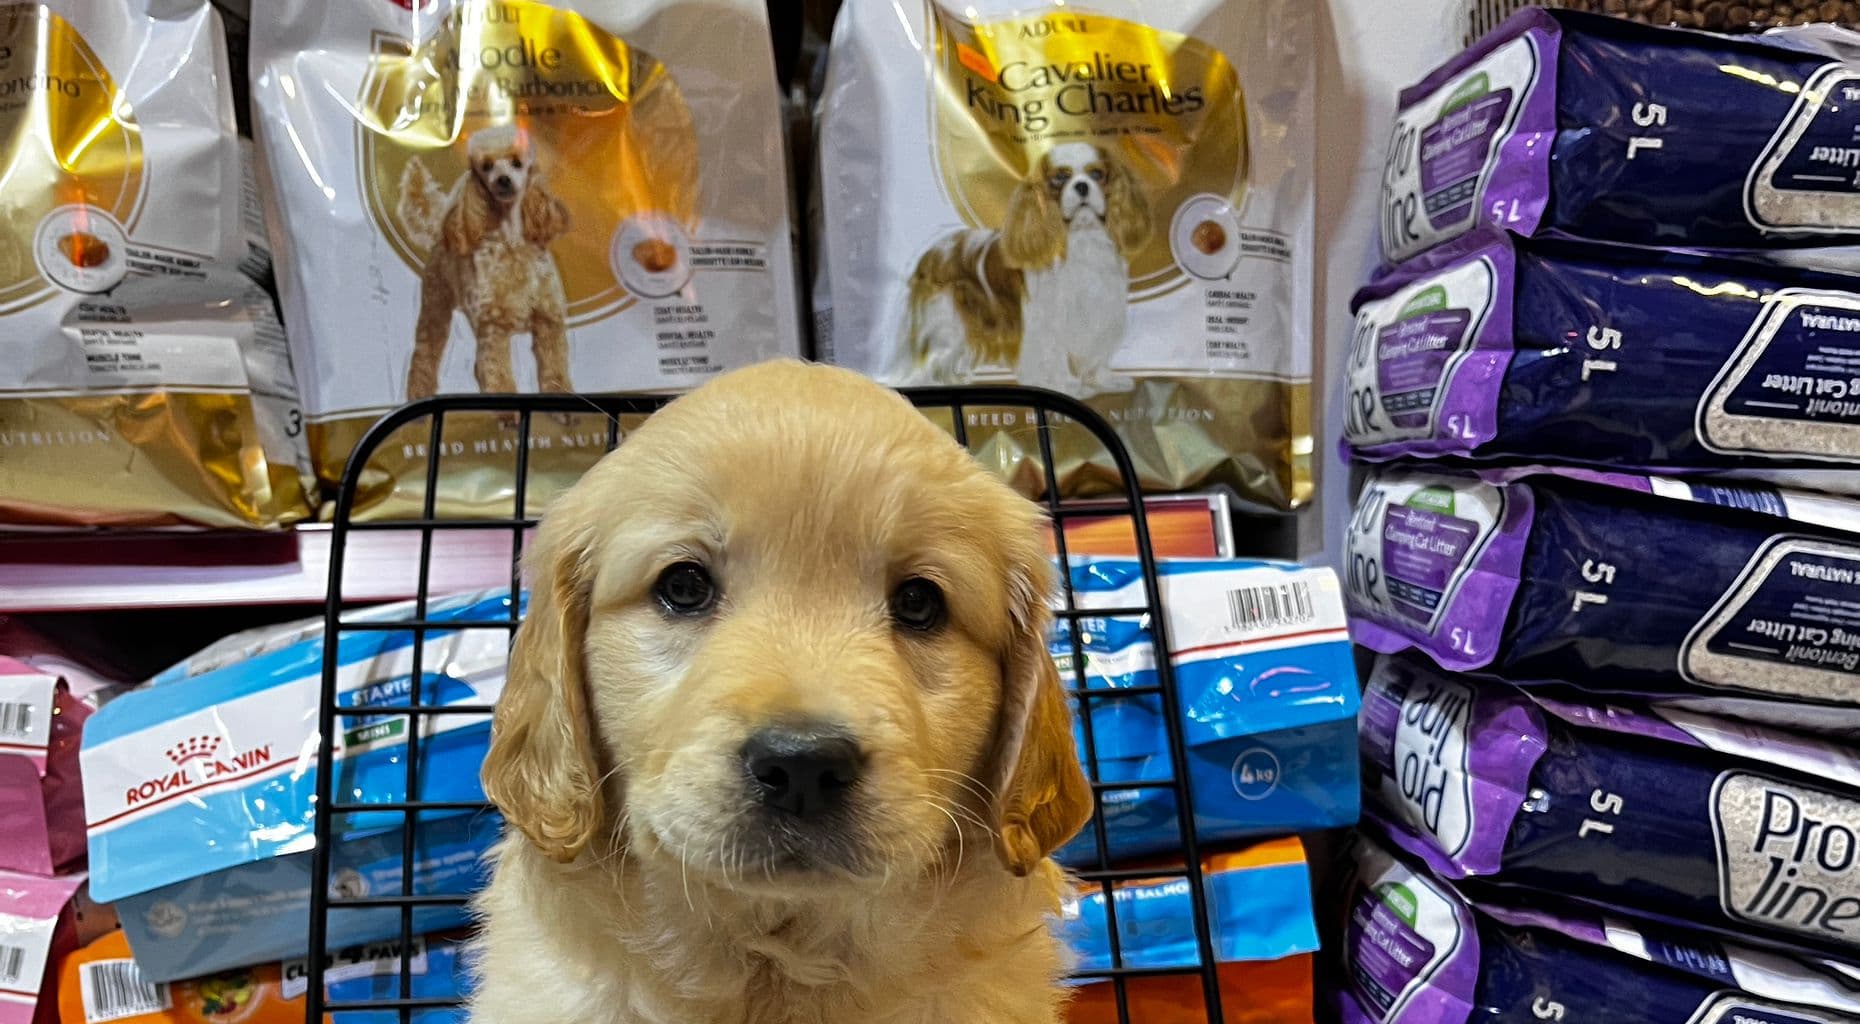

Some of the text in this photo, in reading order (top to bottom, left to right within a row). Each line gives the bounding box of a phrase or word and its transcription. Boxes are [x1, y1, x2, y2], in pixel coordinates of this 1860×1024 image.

[999, 50, 1152, 93] Cavalier
[1056, 82, 1205, 117] Charles
[1627, 102, 1667, 160] 5 L
[1492, 198, 1522, 223] 5 L
[1581, 326, 1622, 382] 5 L
[1762, 374, 1814, 396] Litter
[1816, 378, 1847, 399] Cat
[967, 412, 1017, 427] REED
[1447, 414, 1477, 439] 5 L
[403, 442, 465, 459] BRED
[1572, 558, 1617, 613] 5 L
[1789, 560, 1853, 585] NATURAL
[1450, 626, 1477, 656] 5 L
[1746, 617, 1797, 640] Litter
[1797, 625, 1828, 645] Cat
[1786, 644, 1860, 670] Bentonit
[351, 678, 412, 707] STARTE
[126, 769, 193, 806] ROYAL
[1239, 764, 1254, 785] 4
[1402, 752, 1448, 837] Pro
[1578, 788, 1624, 840] 5 L
[1754, 790, 1857, 873] Pro
[1093, 883, 1192, 905] WTH SALMO
[1745, 856, 1860, 934] line
[1531, 996, 1566, 1022] 5
